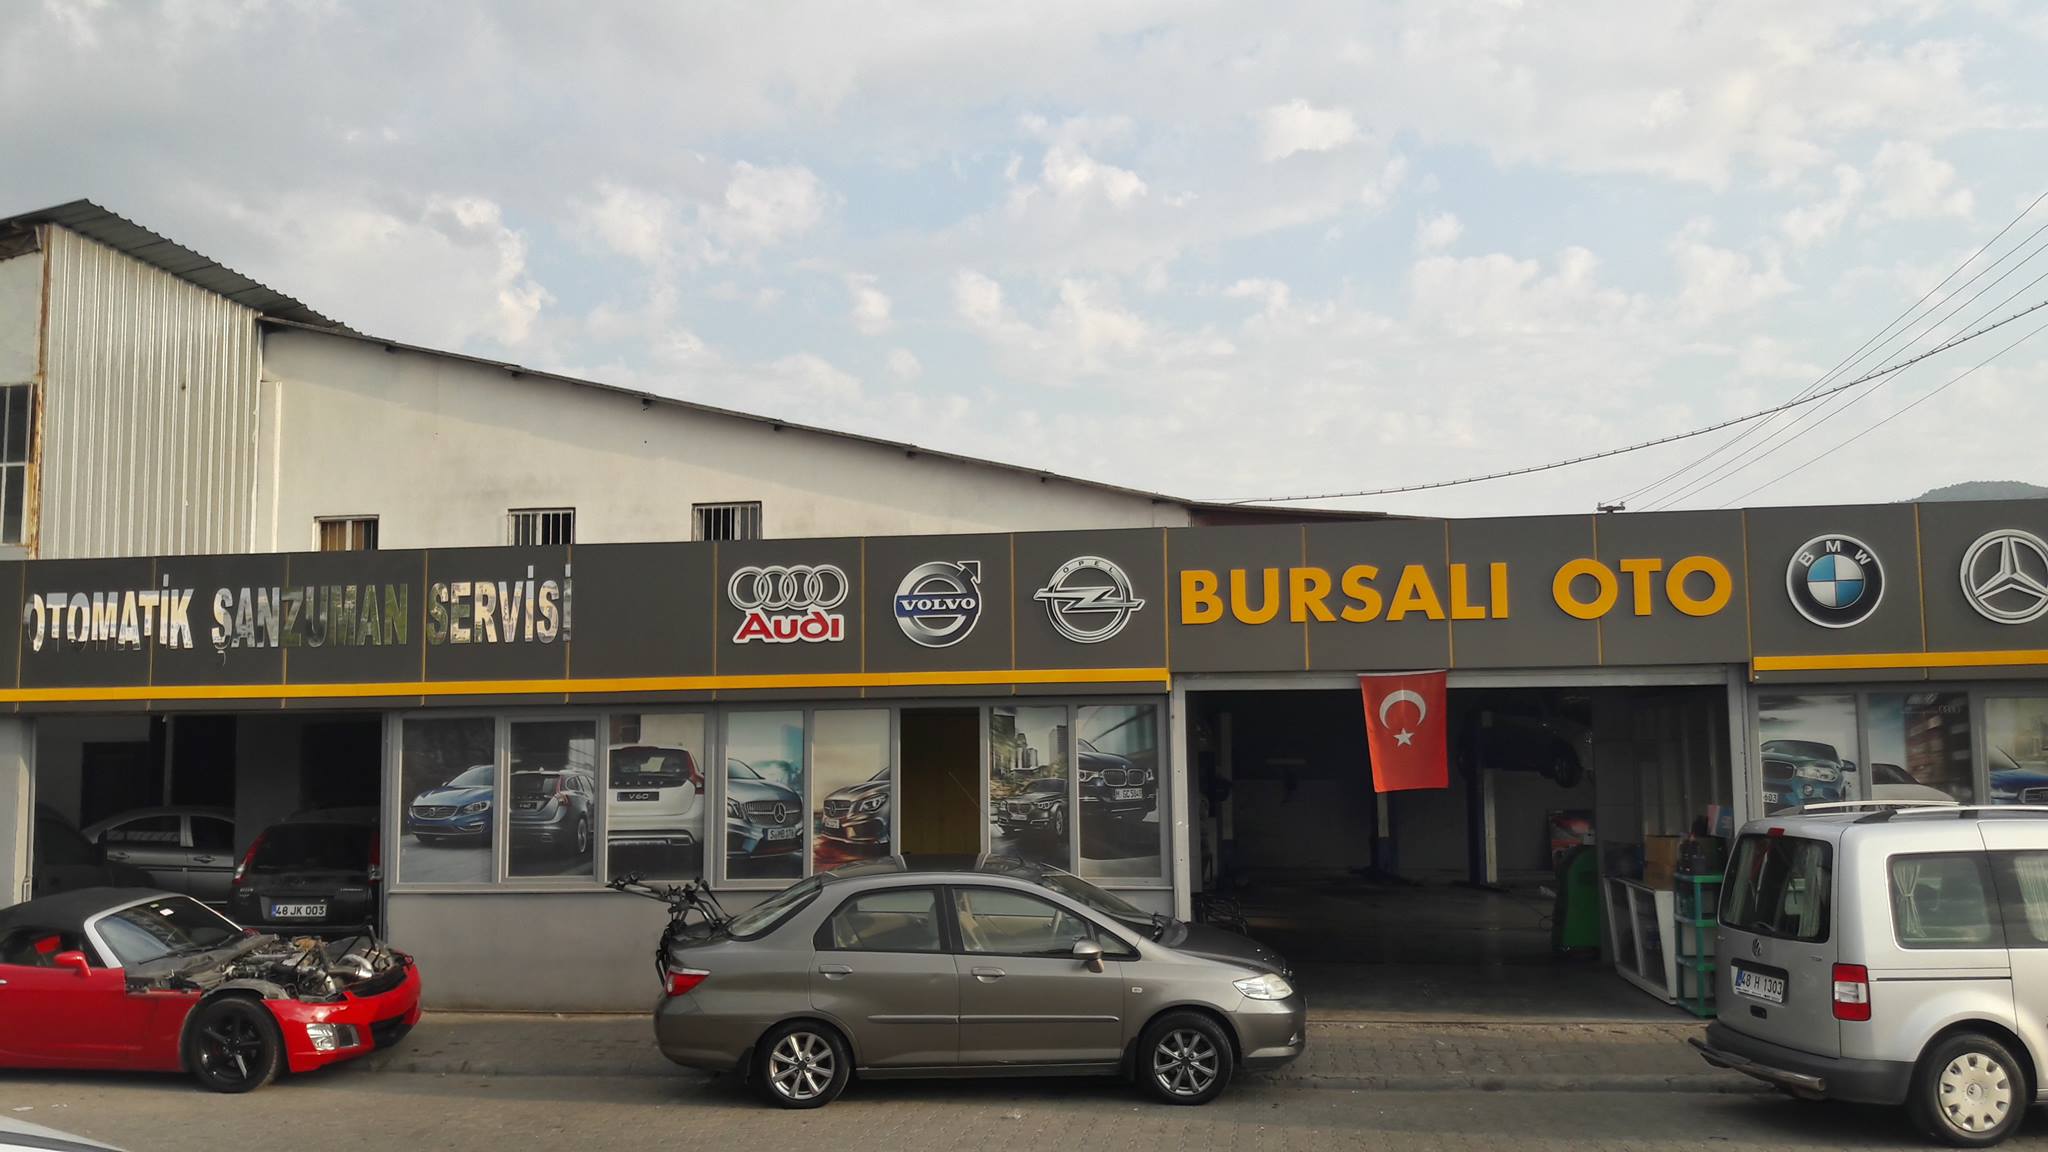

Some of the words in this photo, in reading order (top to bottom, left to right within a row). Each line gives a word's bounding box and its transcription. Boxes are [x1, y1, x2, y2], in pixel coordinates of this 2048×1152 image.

[1797, 540, 1872, 567] BMW
[1062, 560, 1114, 574] OPEL
[1180, 562, 1509, 625] BURSALI
[1552, 555, 1734, 618] OTO
[23, 573, 195, 653] OTOMATİK
[211, 583, 408, 667] ŞANZUMAN
[427, 563, 572, 645] SERVİSİ
[898, 596, 976, 611] VOLVO
[737, 608, 842, 641] Audi
[275, 906, 288, 915] 48
[290, 906, 304, 915] JK
[305, 906, 325, 915] 003
[1741, 973, 1752, 987] 48
[1754, 976, 1760, 990] H
[1763, 978, 1783, 995] 1303
